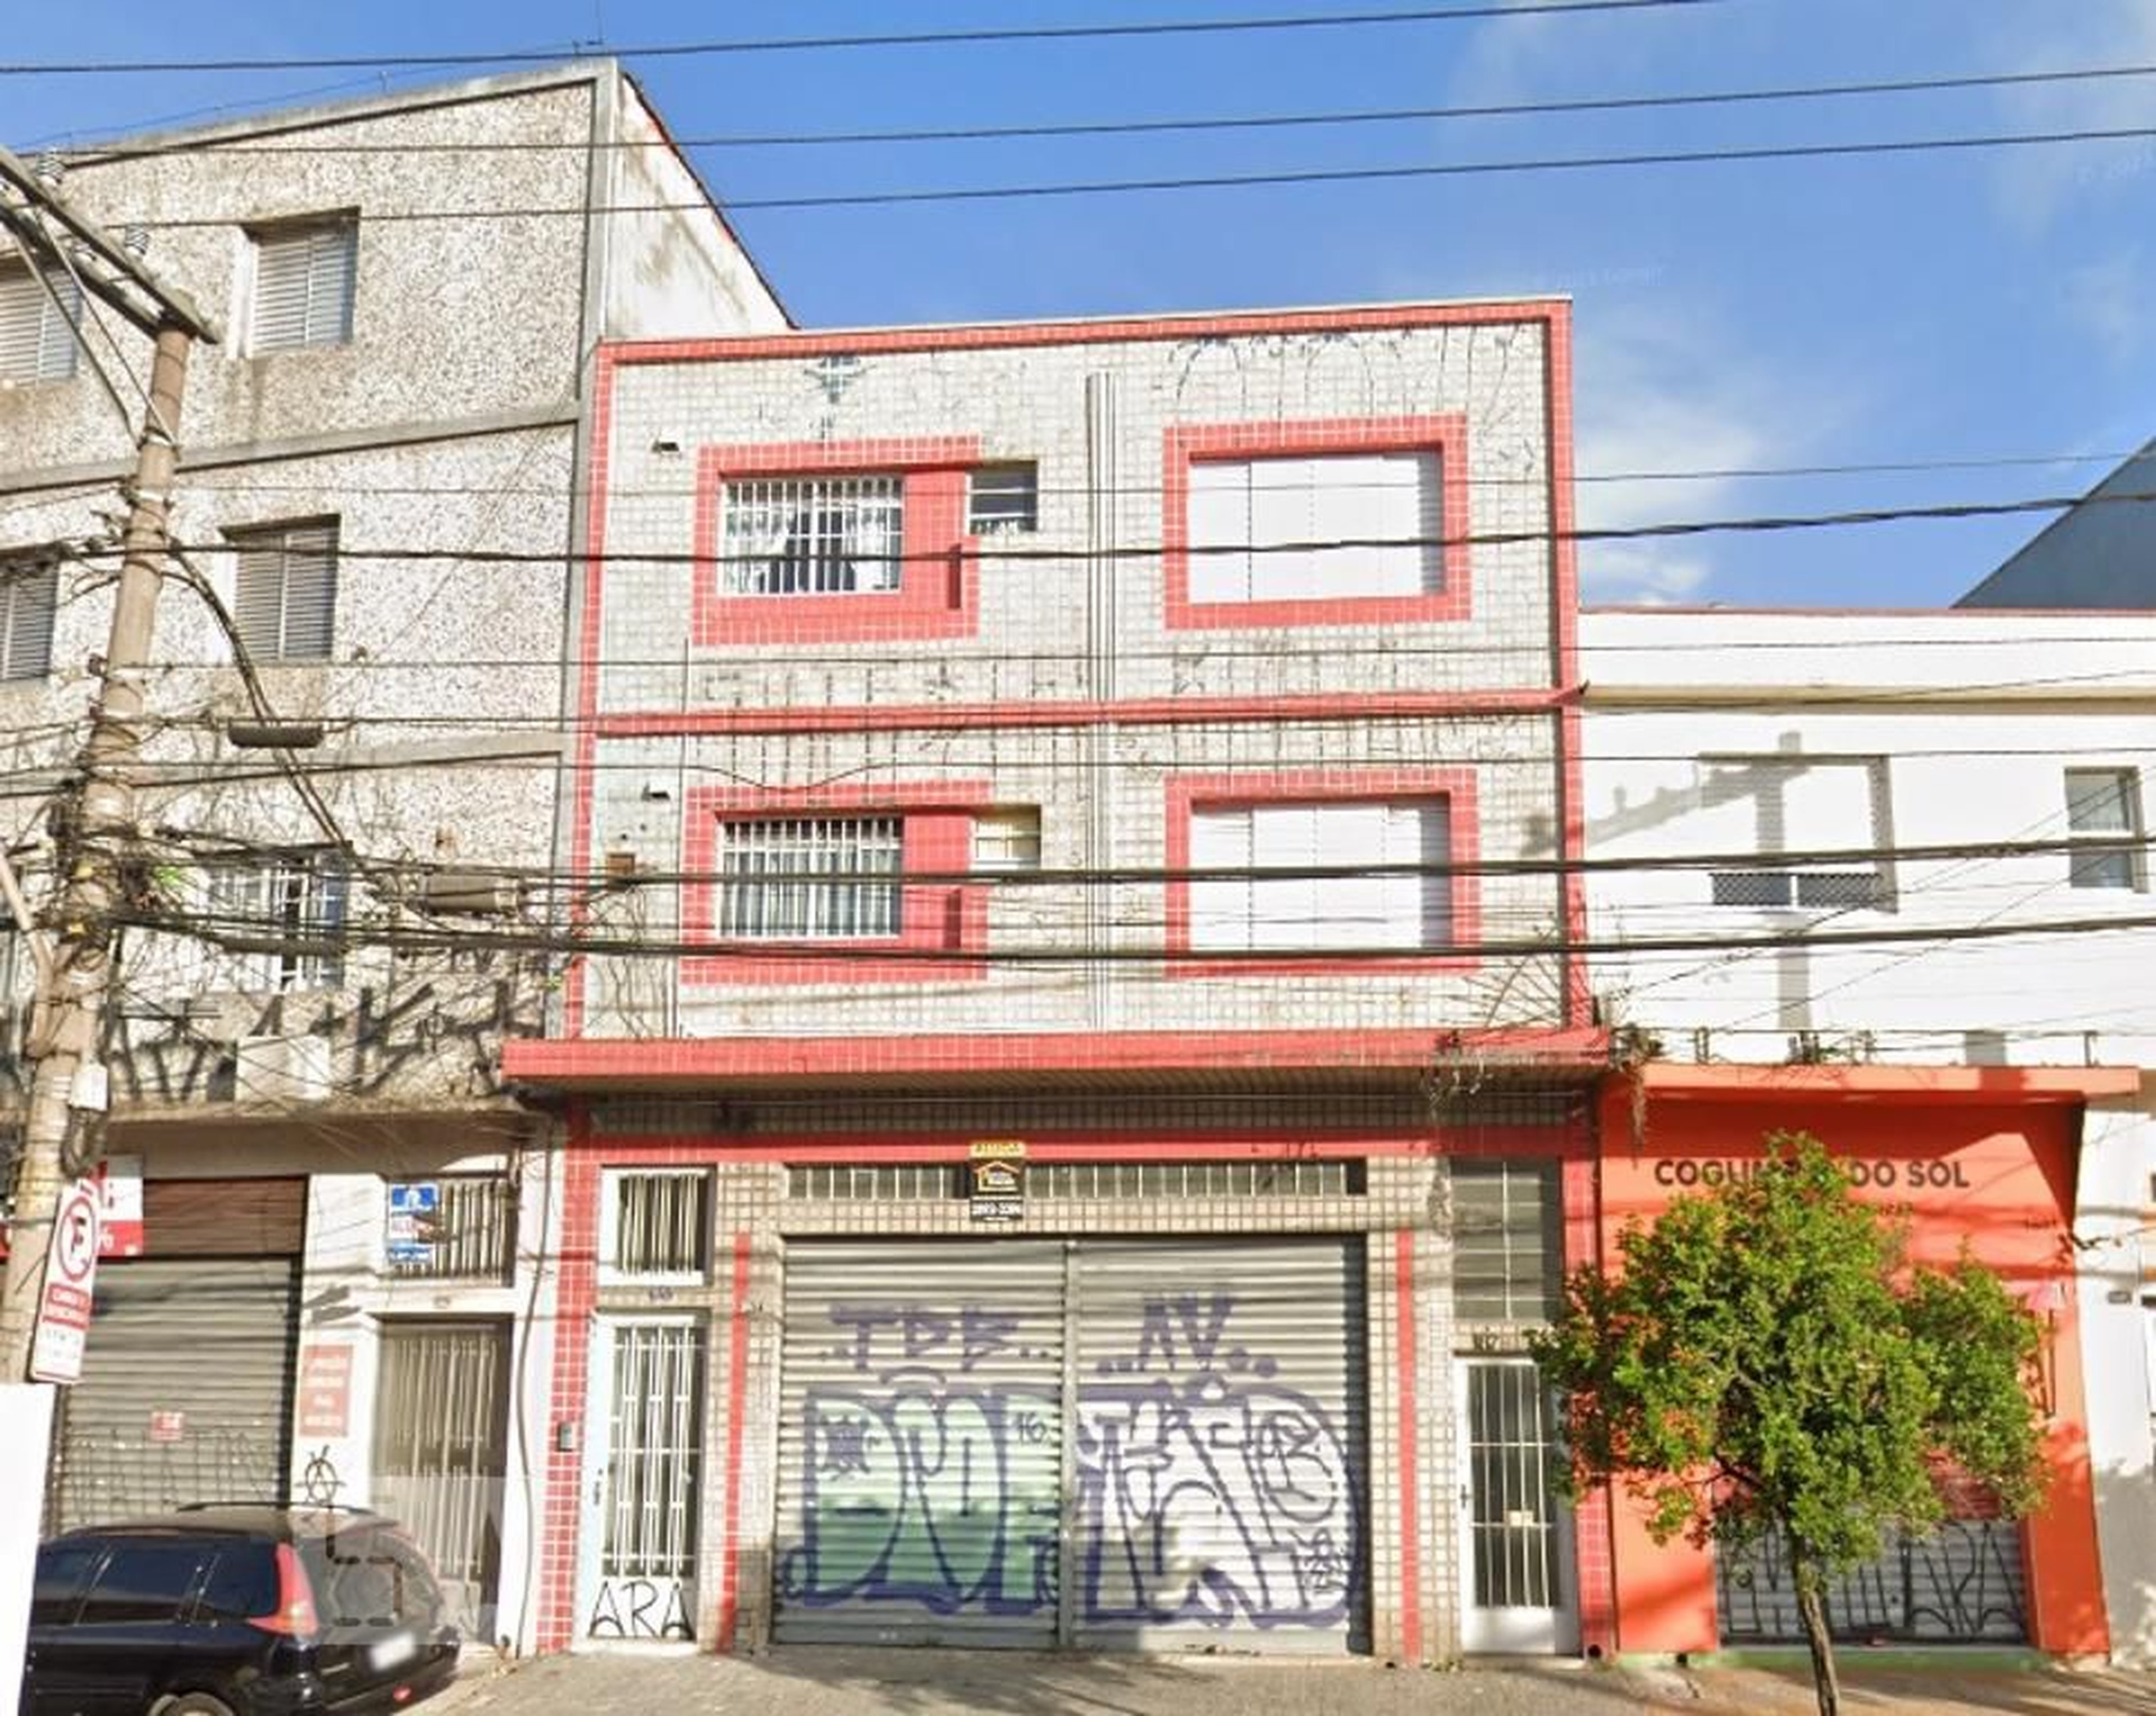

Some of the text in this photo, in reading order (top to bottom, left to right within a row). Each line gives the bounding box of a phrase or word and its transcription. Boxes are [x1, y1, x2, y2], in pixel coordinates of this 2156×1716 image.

[1851, 1160, 1897, 1188] DO
[1908, 1160, 1970, 1188] SOL
[588, 1580, 697, 1643] ARA
